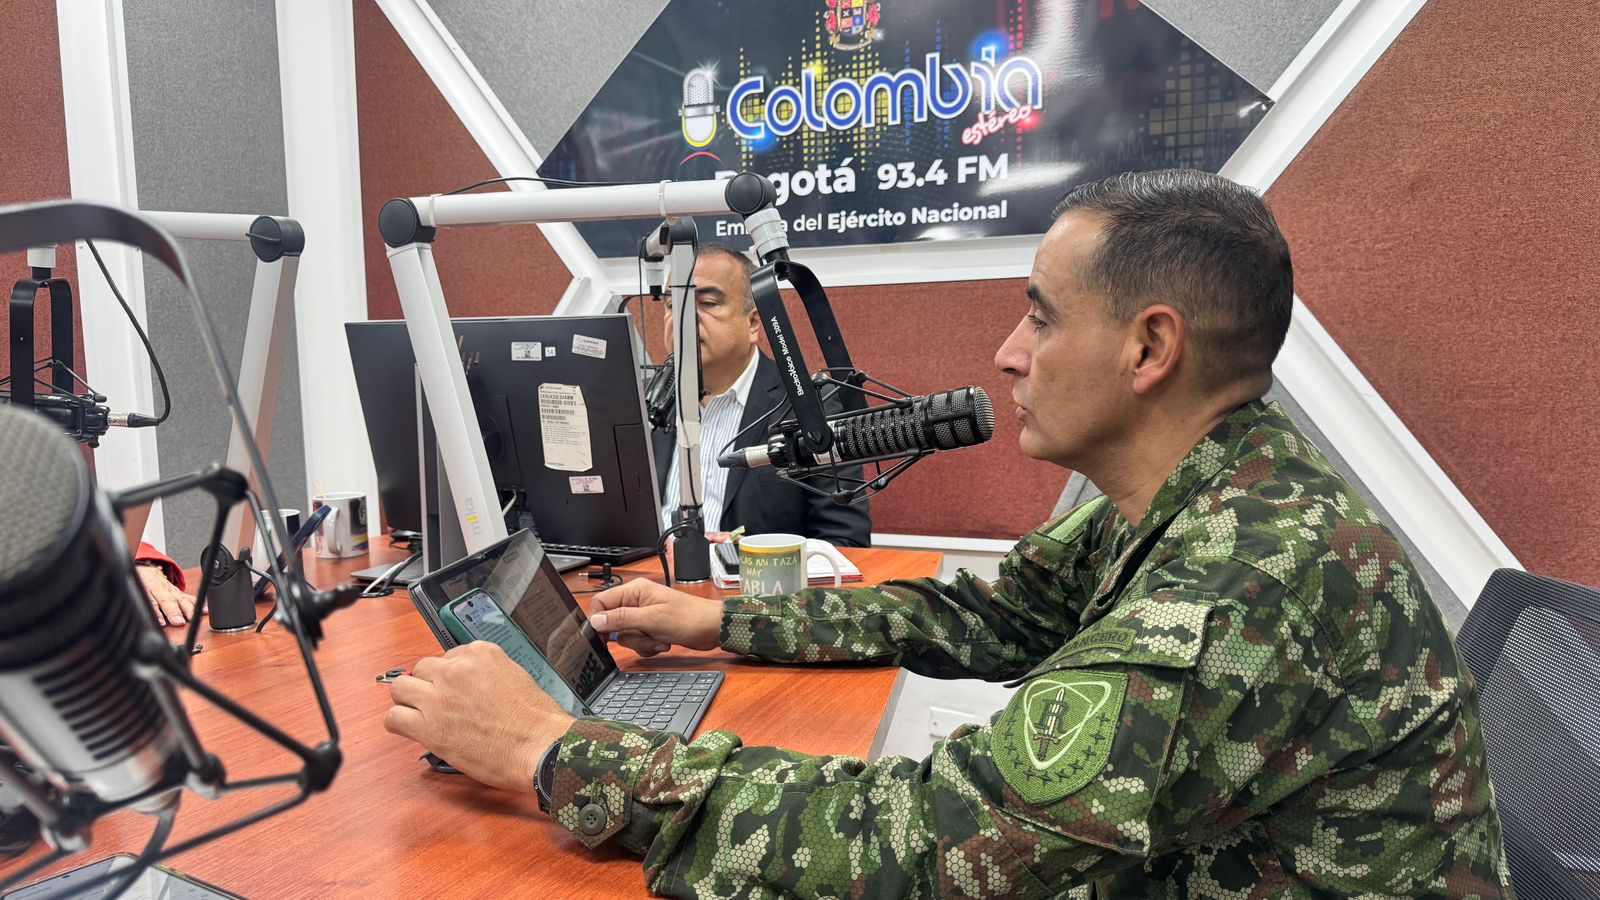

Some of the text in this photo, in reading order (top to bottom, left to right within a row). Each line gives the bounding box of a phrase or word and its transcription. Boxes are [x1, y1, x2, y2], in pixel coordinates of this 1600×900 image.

[726, 46, 1042, 140] Colombia
[961, 105, 1033, 145] estéreo
[715, 153, 1009, 206] gotá 93.4 FM
[793, 213, 822, 231] del
[828, 210, 906, 233] Ejército
[911, 200, 1008, 224] Nacional
